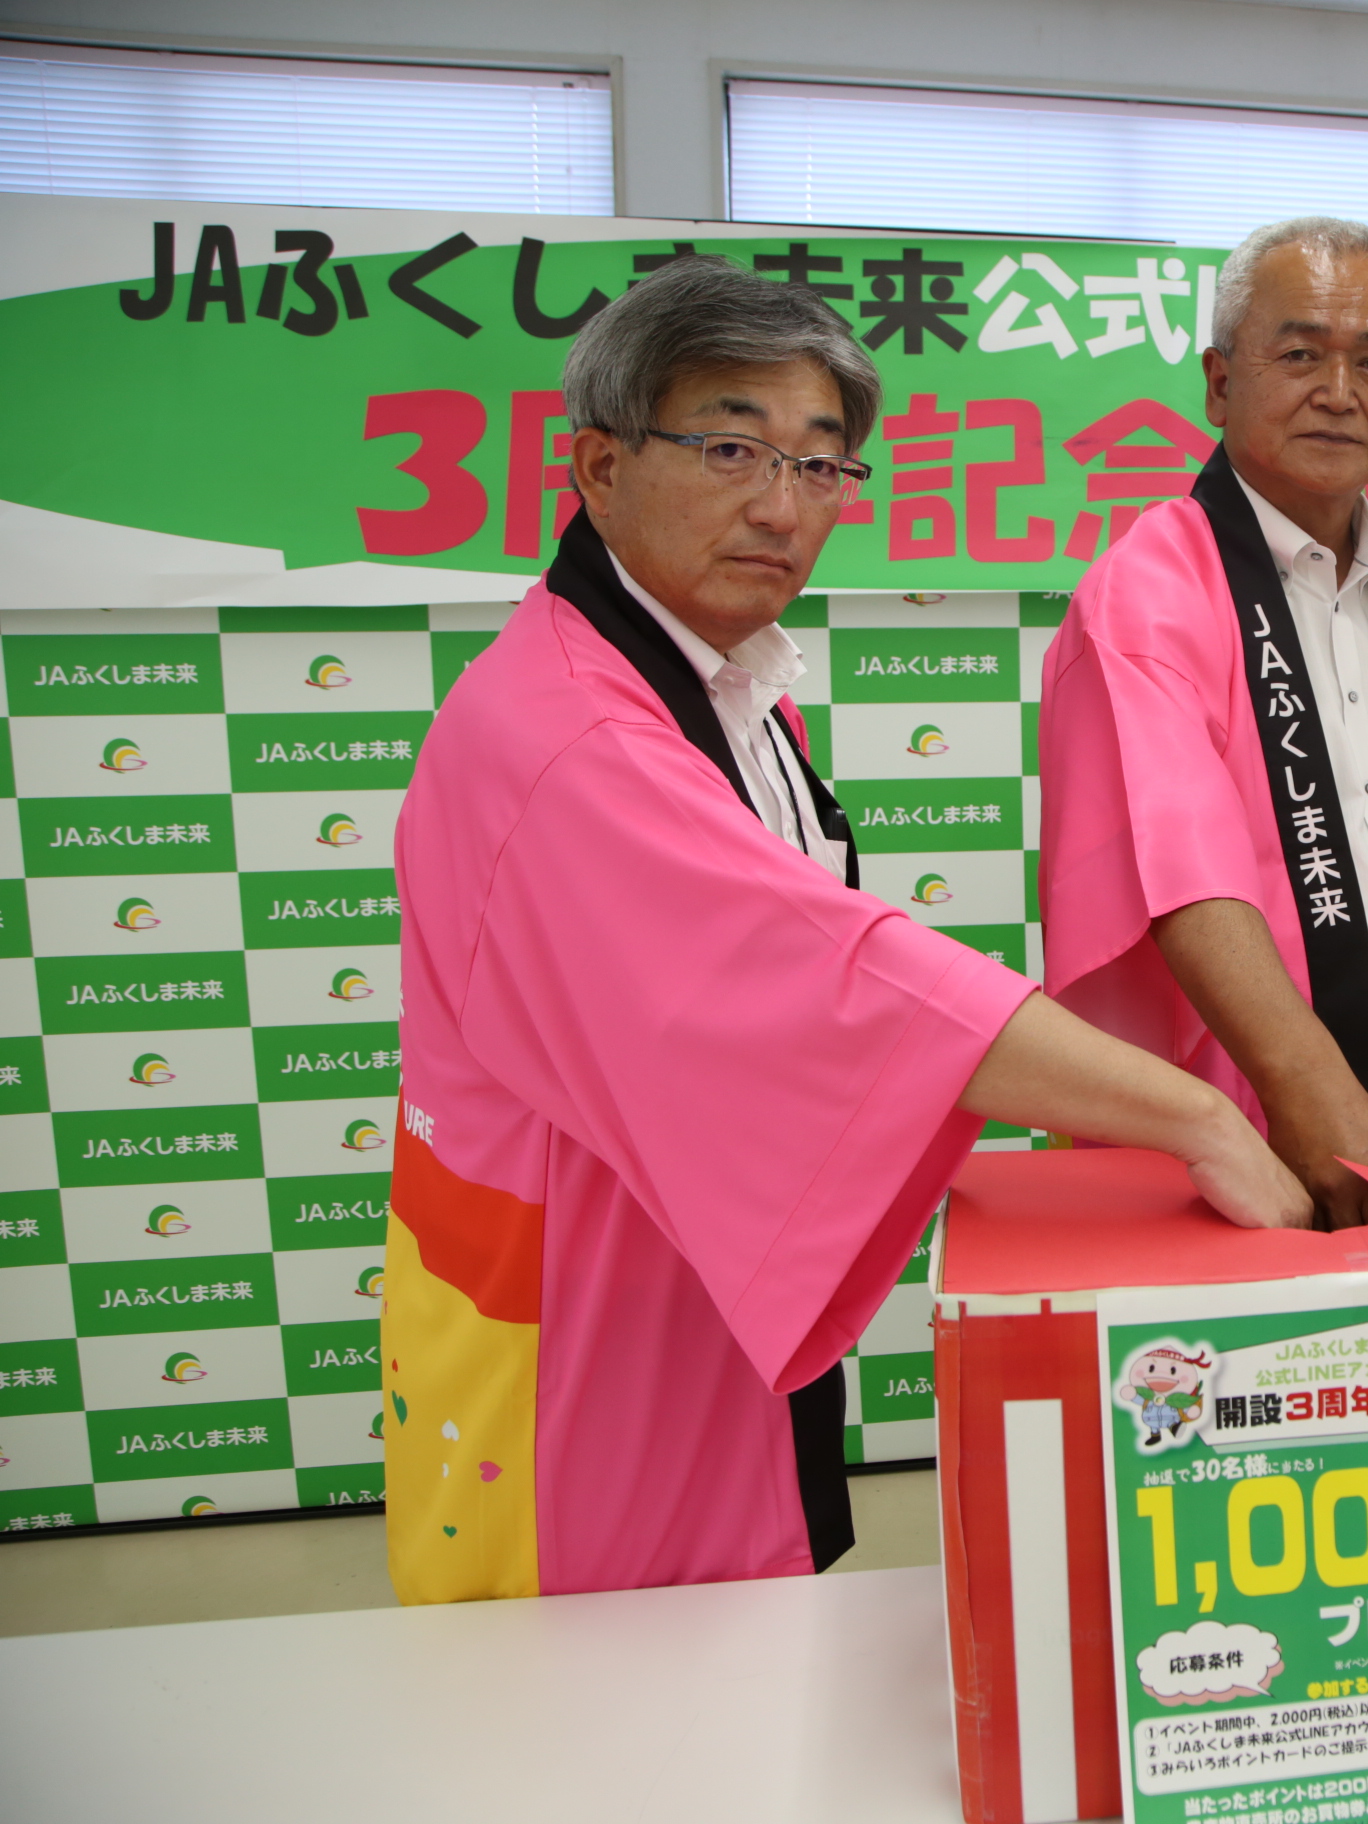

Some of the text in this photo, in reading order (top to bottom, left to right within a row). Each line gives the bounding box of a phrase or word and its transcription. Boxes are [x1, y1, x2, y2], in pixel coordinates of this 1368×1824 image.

[34, 663, 199, 686] JAふくしま未来
[855, 655, 999, 676] JAふくしま未来
[256, 740, 413, 763] JAふくしま未来
[1253, 603, 1351, 929] JAふくしま未来
[859, 804, 1002, 827] JAふくしま未来
[49, 823, 211, 848] JAふくしま未来
[66, 980, 225, 1005] JAふくしま未来
[82, 1132, 239, 1159] JAふくしま未来
[99, 1281, 254, 1308] JAふくしま未来
[117, 1425, 269, 1455] JAふくしま未来
[1169, 1651, 1244, 1675] 応募条件
